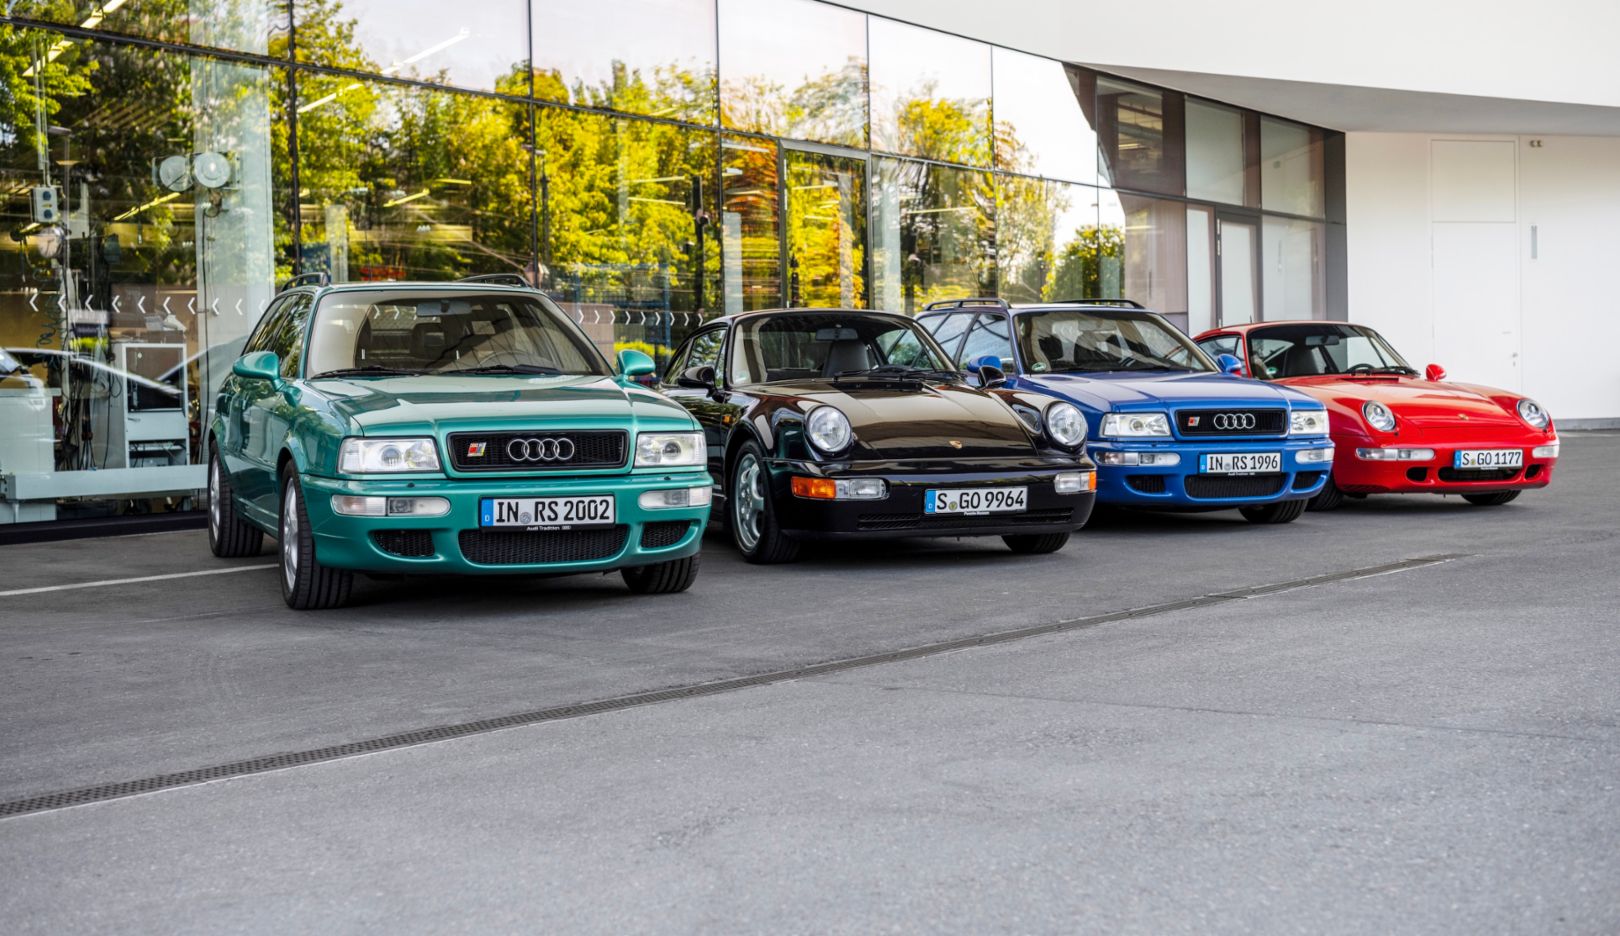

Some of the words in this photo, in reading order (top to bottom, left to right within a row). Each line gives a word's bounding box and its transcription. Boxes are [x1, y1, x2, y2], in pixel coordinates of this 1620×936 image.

[1208, 456, 1223, 471] IN
[1232, 455, 1248, 470] RS
[1250, 455, 1278, 470] 1996
[1462, 452, 1470, 466] S
[1477, 452, 1492, 465] GO
[1494, 451, 1521, 465] 1177
[936, 492, 948, 510] S
[959, 491, 981, 510] GO
[984, 490, 1024, 509] 9964
[495, 501, 519, 523] IN
[534, 500, 559, 522] RS
[563, 499, 610, 521] 2002
